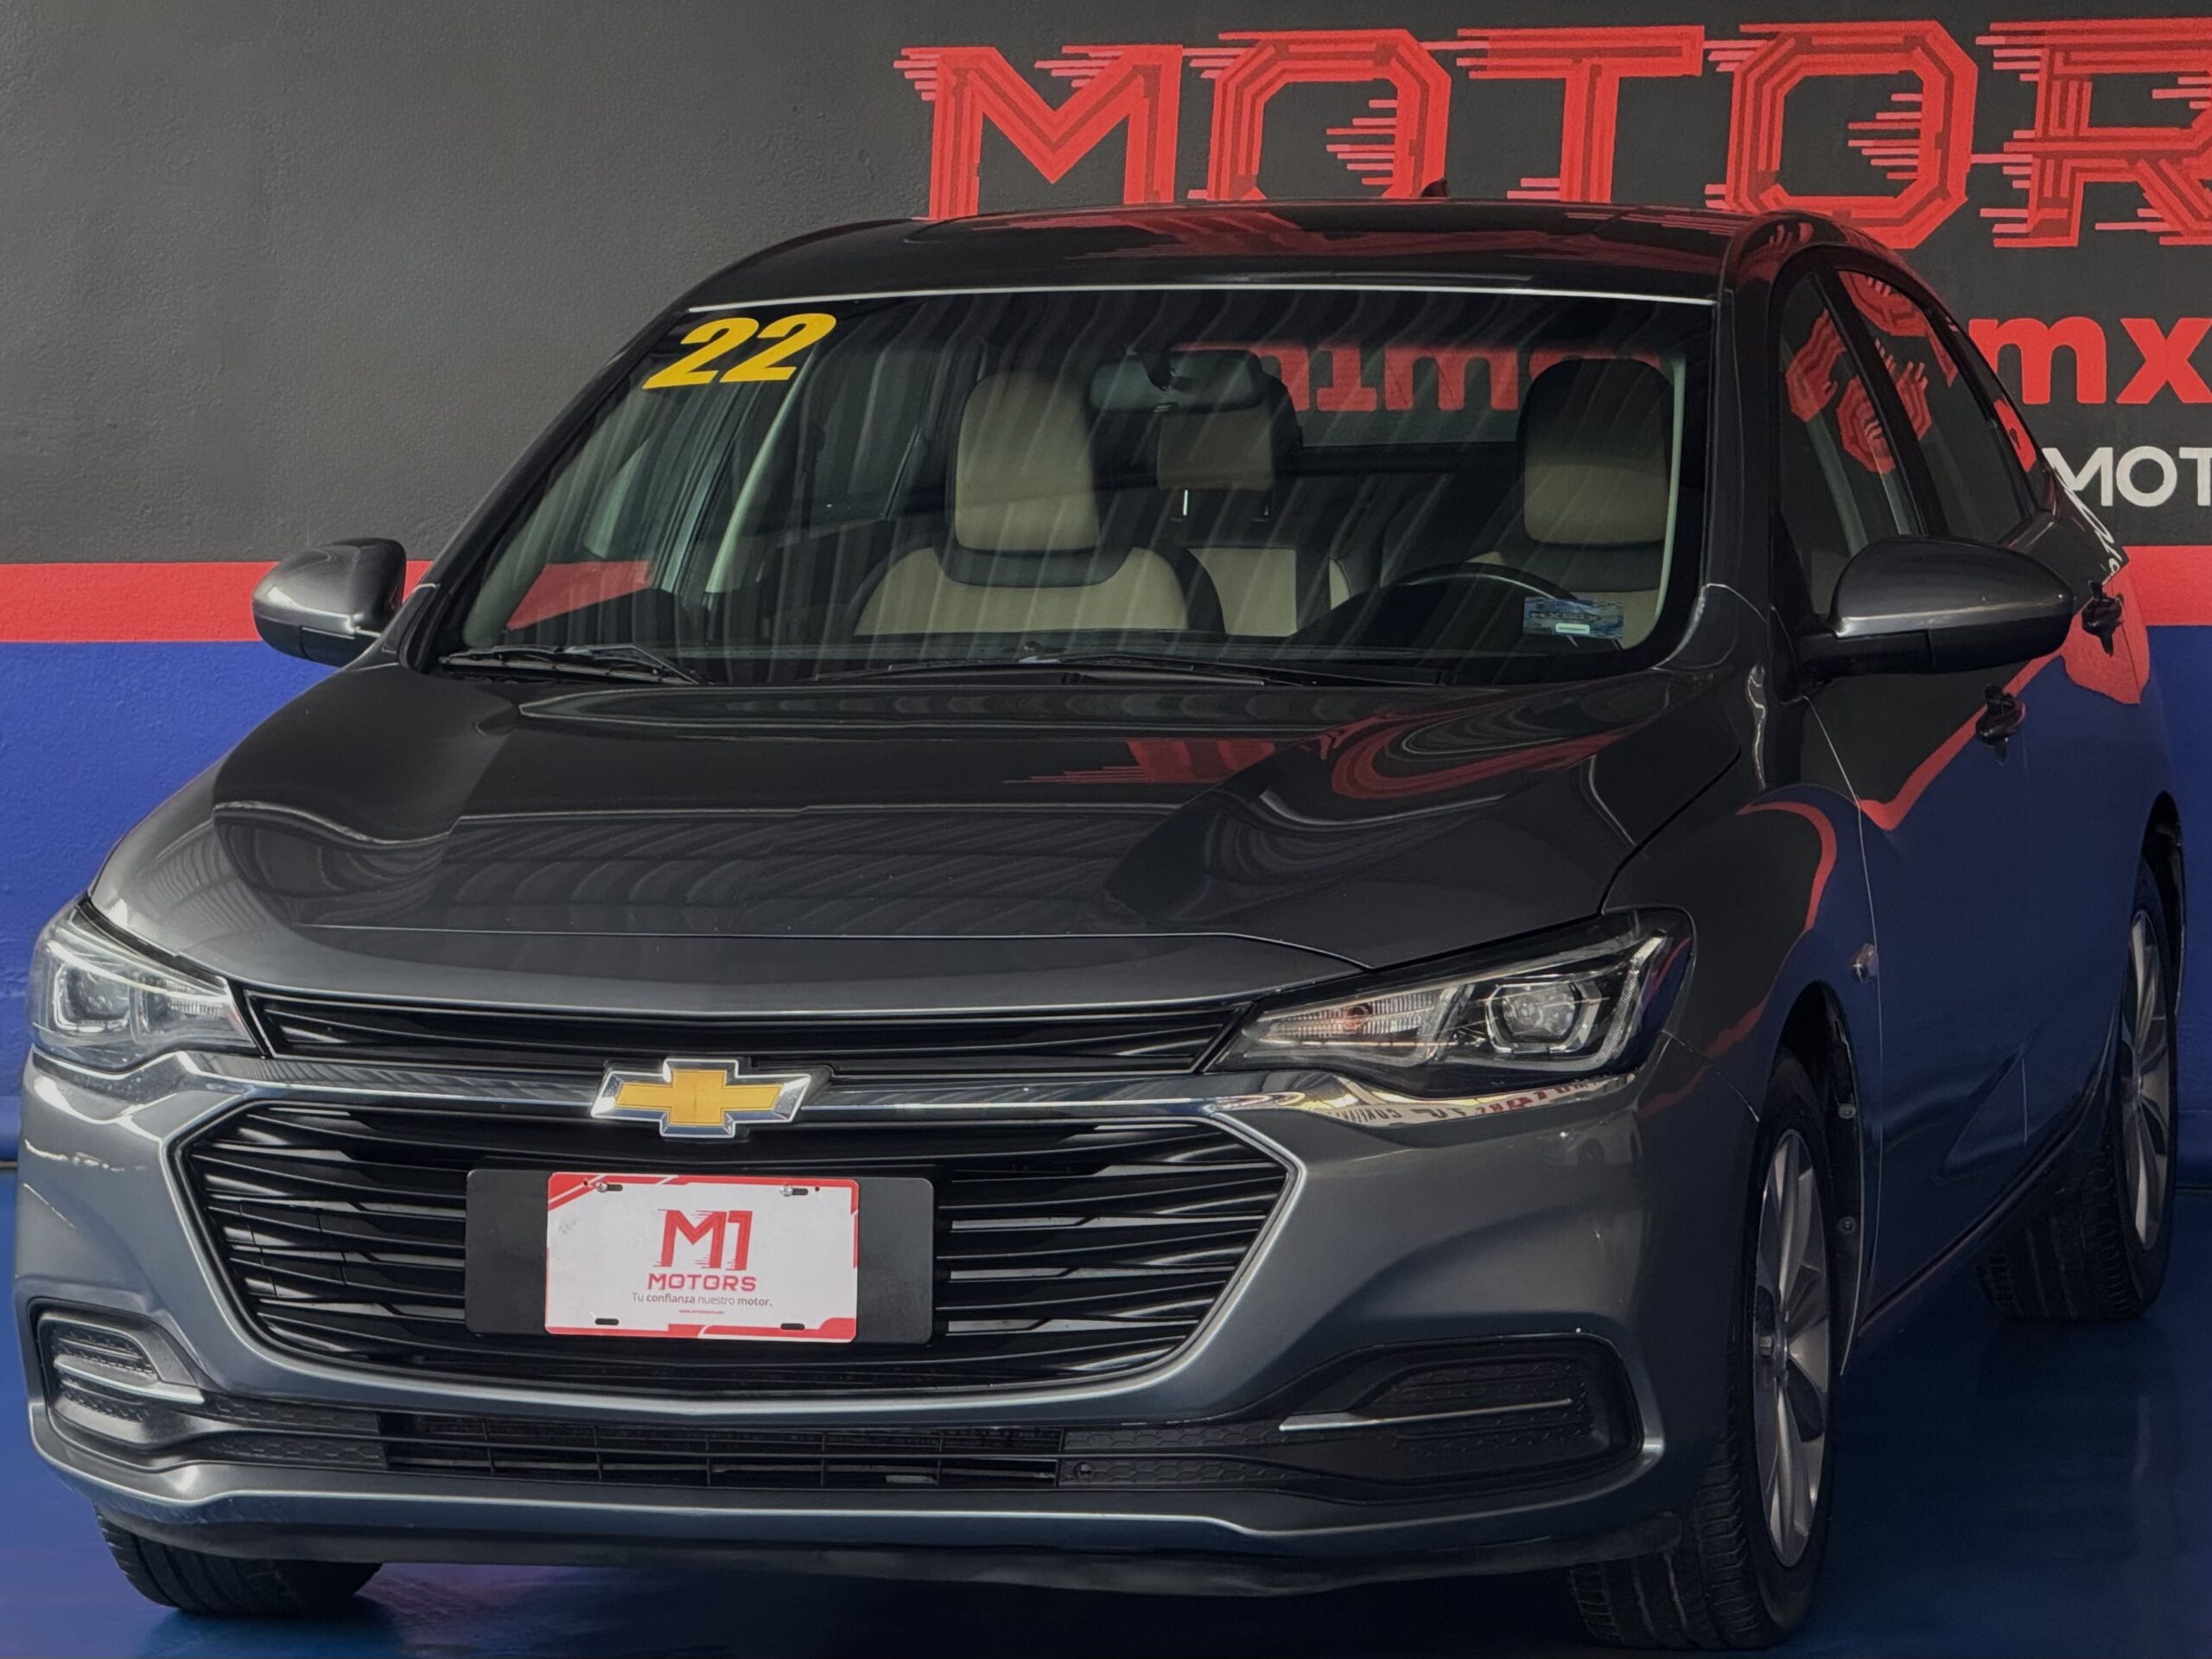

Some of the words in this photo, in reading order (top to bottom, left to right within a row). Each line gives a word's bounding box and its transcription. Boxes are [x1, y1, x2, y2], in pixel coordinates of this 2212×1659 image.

[642, 313, 836, 389] 22
[653, 1208, 753, 1271] M1
[632, 1293, 645, 1302] Tu
[646, 1294, 696, 1304] confianza
[697, 1295, 735, 1306] nuestro
[737, 1297, 773, 1306] motor.
[647, 1273, 758, 1292] MOTORS
